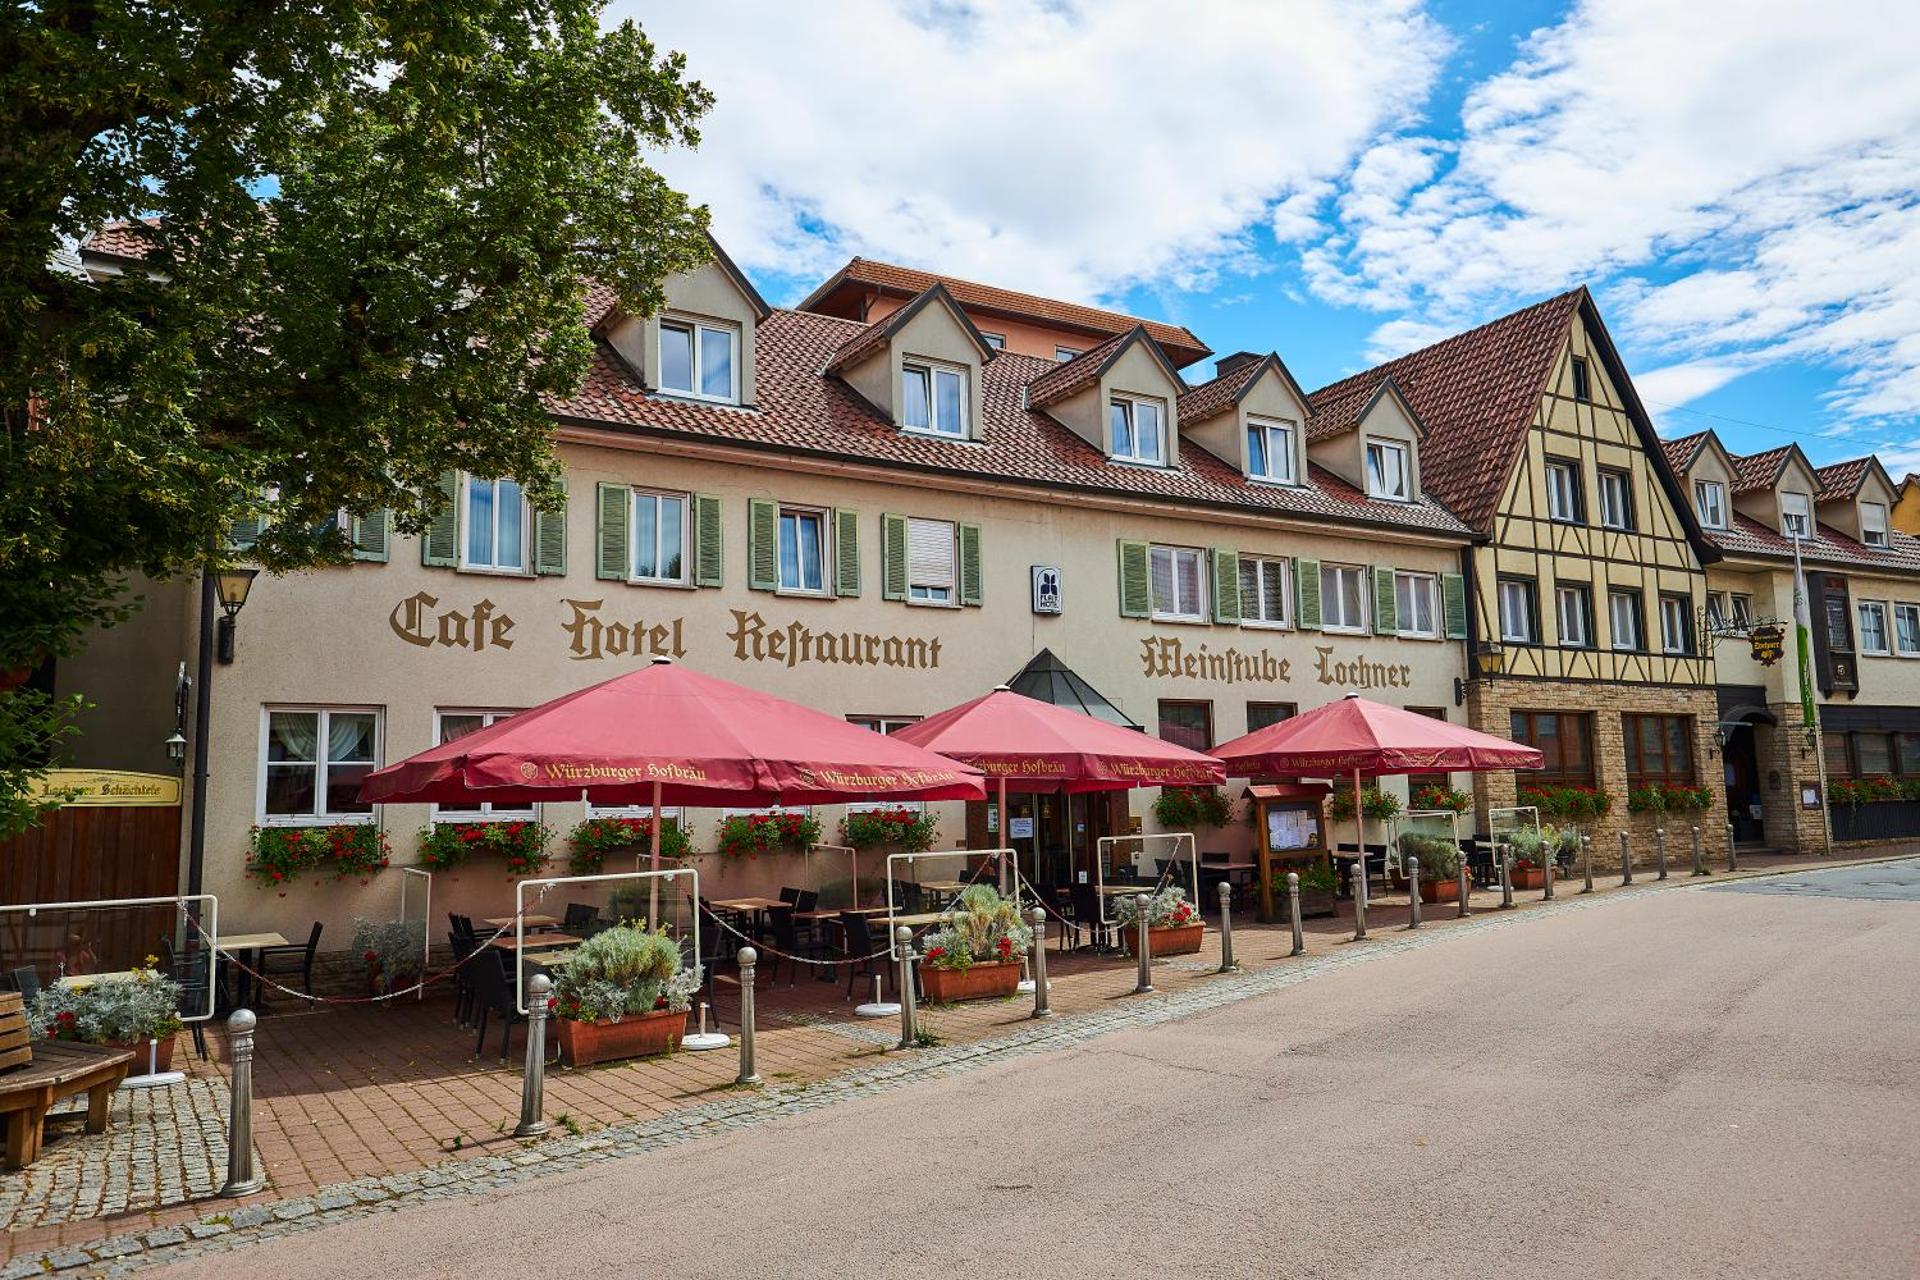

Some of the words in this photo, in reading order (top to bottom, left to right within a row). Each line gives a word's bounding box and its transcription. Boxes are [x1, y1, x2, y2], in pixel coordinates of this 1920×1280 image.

[389, 590, 516, 651] Cafe
[561, 599, 687, 660] Hotel
[1313, 645, 1411, 689] Lochner
[545, 762, 641, 781] Würzburger
[647, 763, 706, 782] Hofbräu
[1022, 759, 1066, 775] Hofbräu
[1111, 762, 1171, 779] Würzburger
[819, 769, 898, 789] Würzburger
[901, 768, 954, 786] Hofbräu
